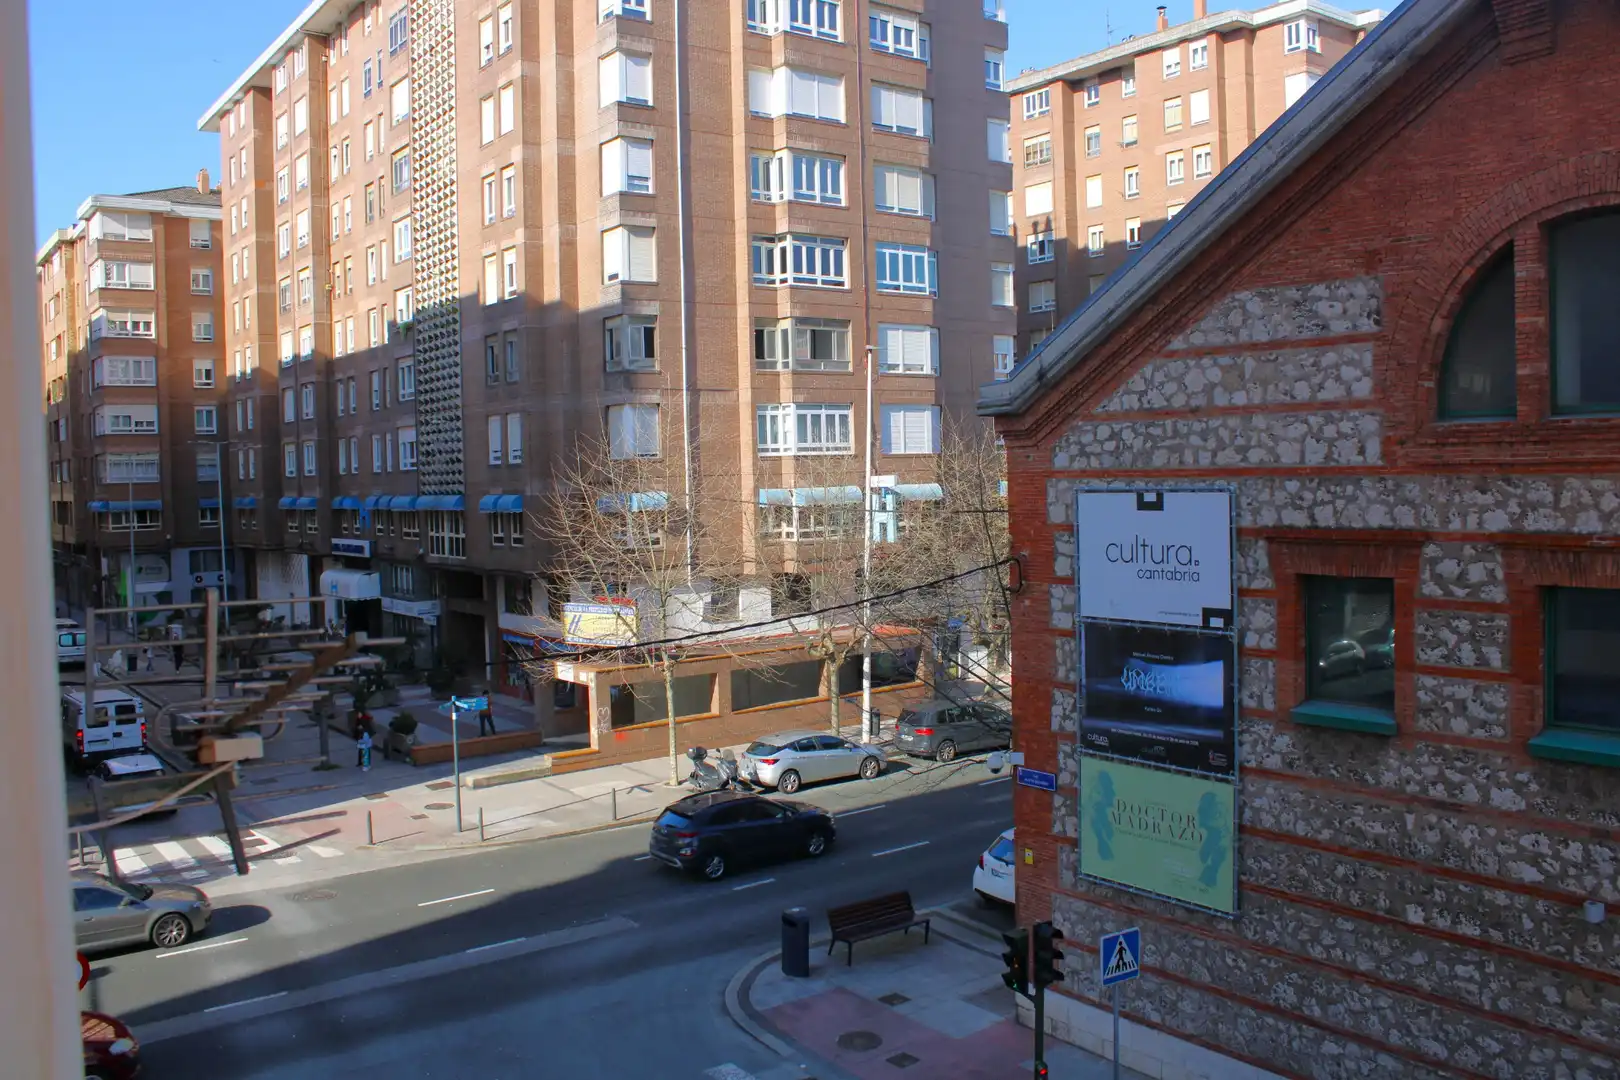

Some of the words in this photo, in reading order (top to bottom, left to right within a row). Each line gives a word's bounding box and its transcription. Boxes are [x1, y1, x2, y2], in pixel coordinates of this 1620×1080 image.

[1136, 566, 1200, 582] cantabria
[1111, 811, 1203, 842] MADRAZO
[1116, 799, 1196, 829] DOCTOR
